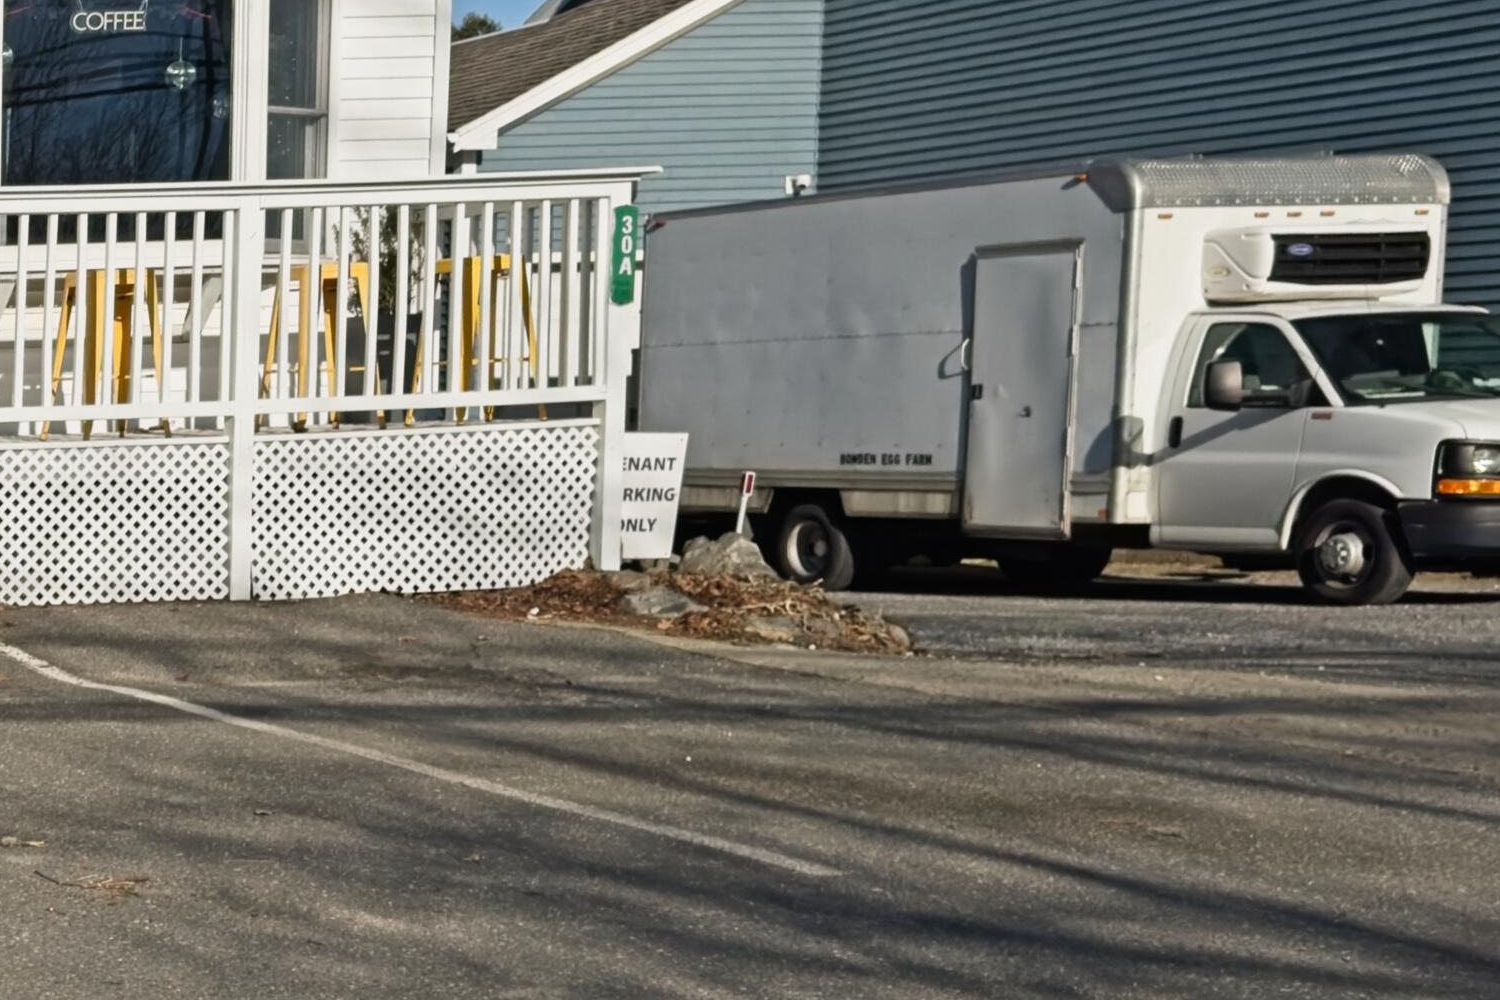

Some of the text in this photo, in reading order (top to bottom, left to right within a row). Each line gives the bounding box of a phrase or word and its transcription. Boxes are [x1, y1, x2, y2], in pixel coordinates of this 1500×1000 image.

[72, 10, 145, 31] COFFEE
[619, 215, 633, 275] 30A
[623, 457, 676, 471] NANT
[881, 453, 900, 466] EGG
[905, 453, 933, 466] FARM
[623, 488, 675, 502] RKING
